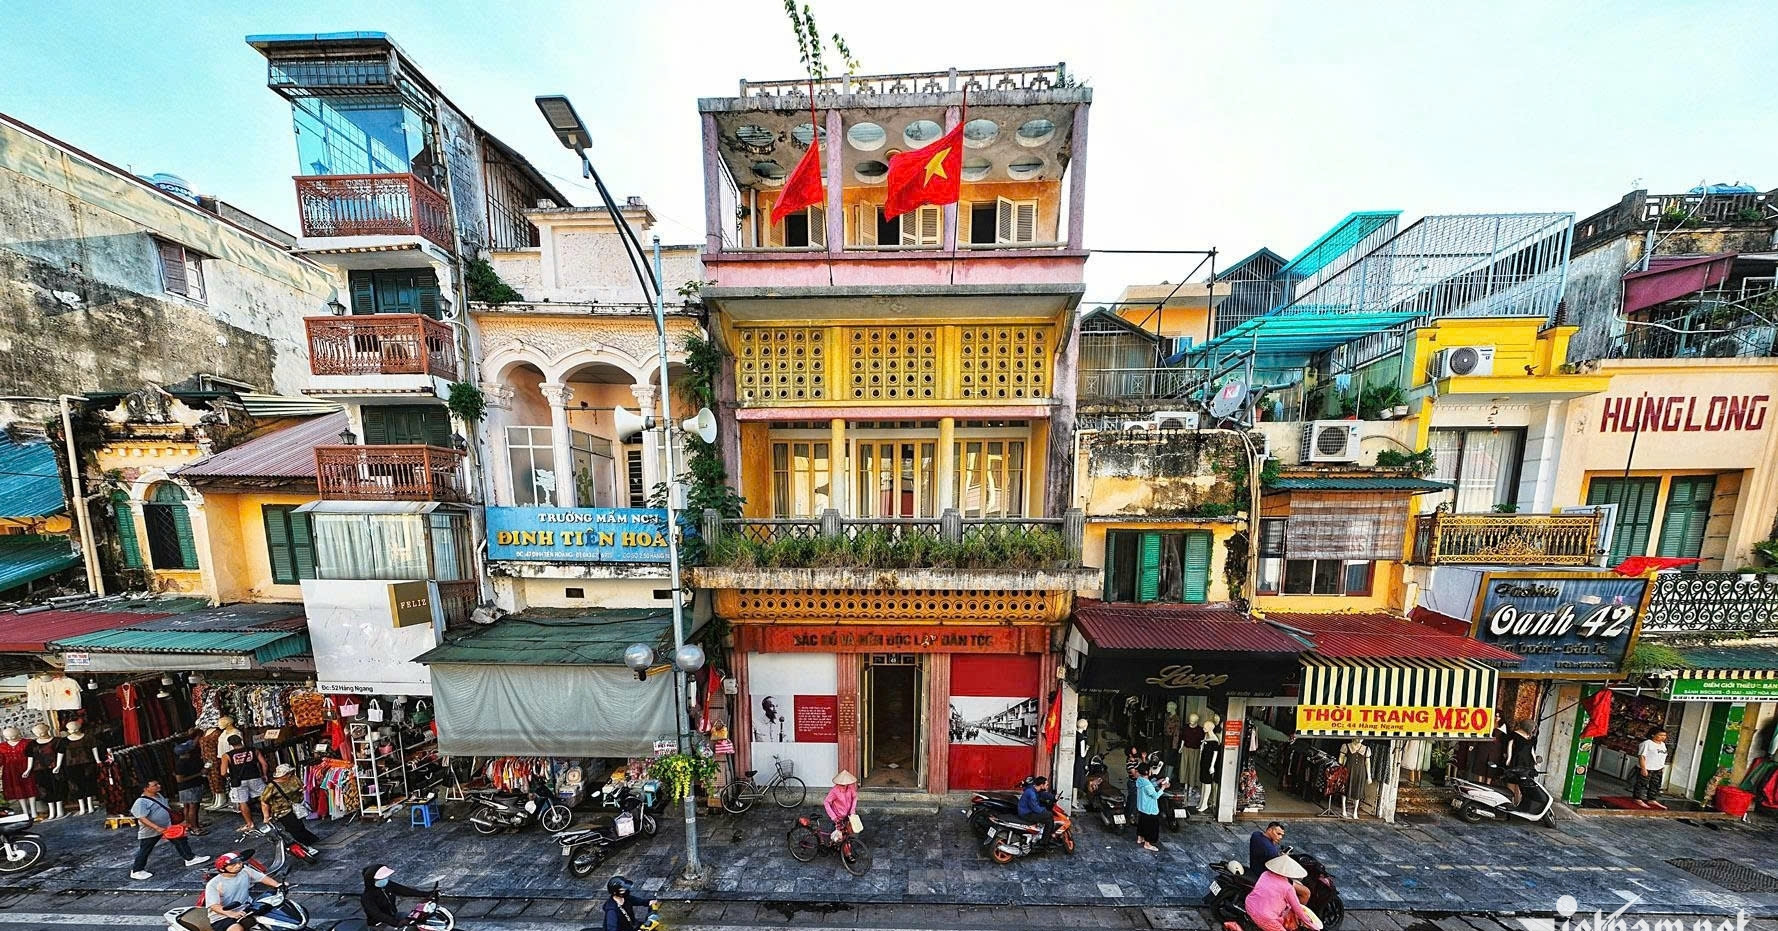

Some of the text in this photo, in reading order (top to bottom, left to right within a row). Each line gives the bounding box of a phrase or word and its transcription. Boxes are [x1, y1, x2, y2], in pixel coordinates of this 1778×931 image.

[1684, 395, 1769, 432] LONG
[497, 531, 553, 546] ĐINH
[561, 527, 615, 547] TIÊN
[400, 599, 427, 609] FELIZ
[1490, 604, 1634, 638] Oanh 42
[355, 684, 374, 693] Ngang
[1303, 705, 1488, 731] THỜI TRANG MEO
[1358, 722, 1378, 730] Hàng
